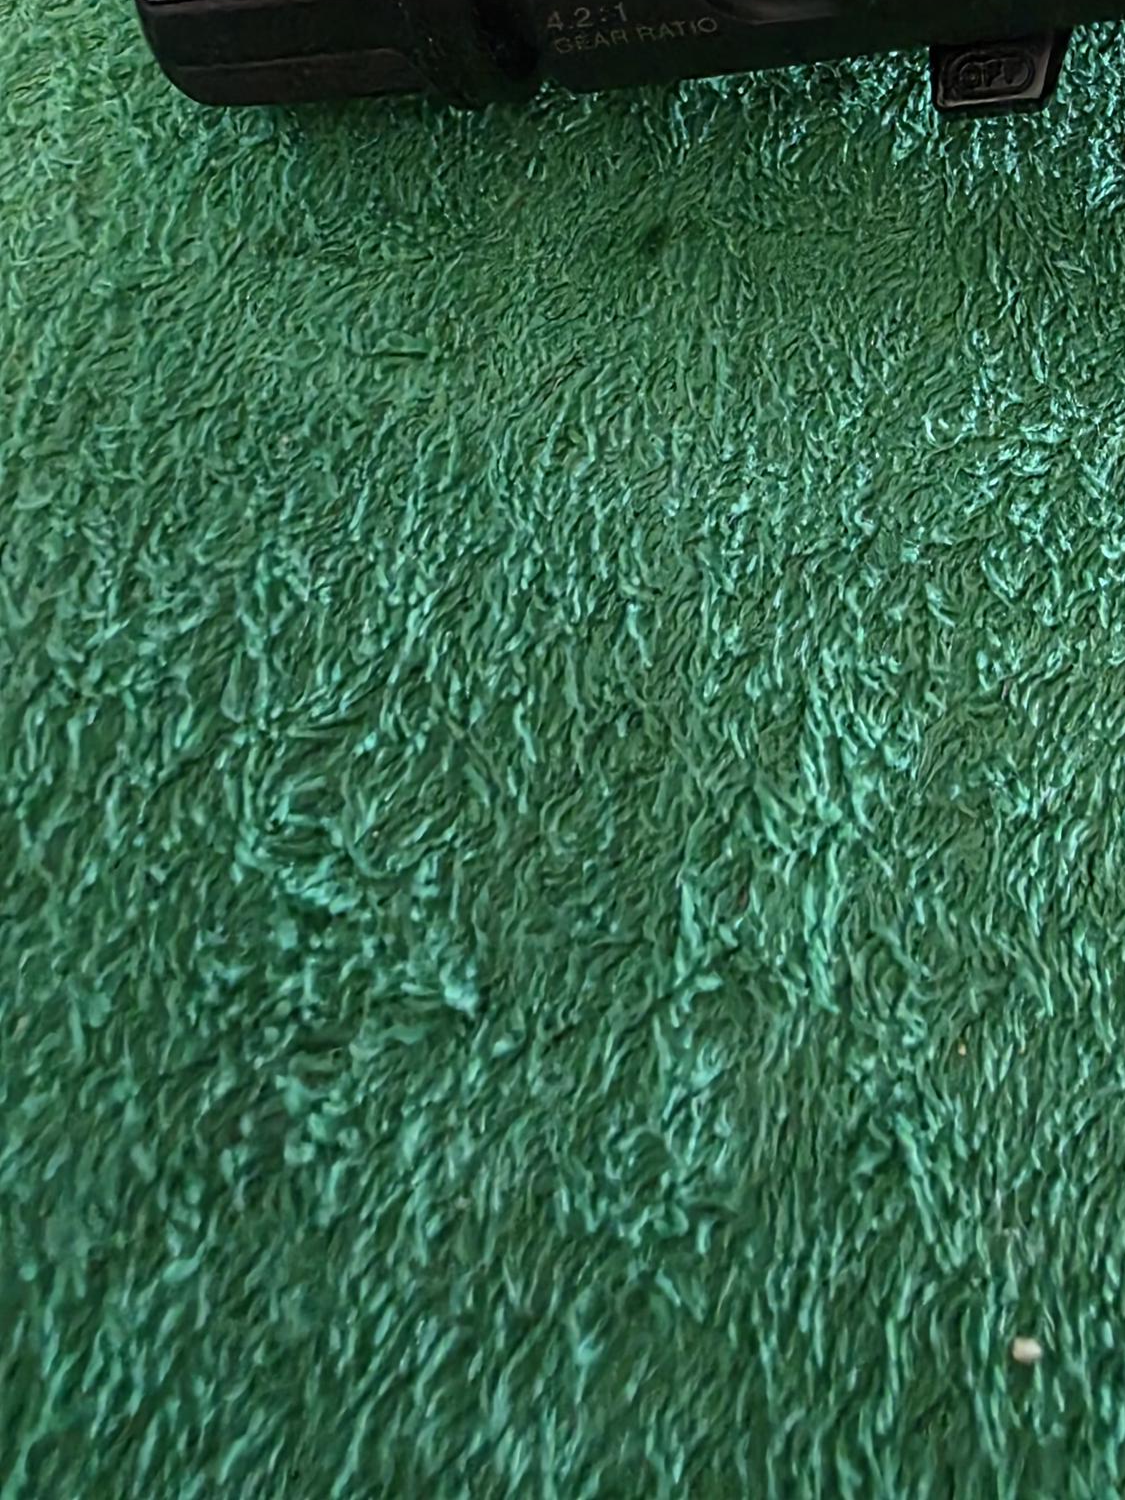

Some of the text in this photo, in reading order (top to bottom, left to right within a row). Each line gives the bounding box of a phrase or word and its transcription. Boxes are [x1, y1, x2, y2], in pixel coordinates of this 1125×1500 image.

[546, 1, 628, 31] 4.2:1
[554, 17, 718, 54] GEAR RATIO
